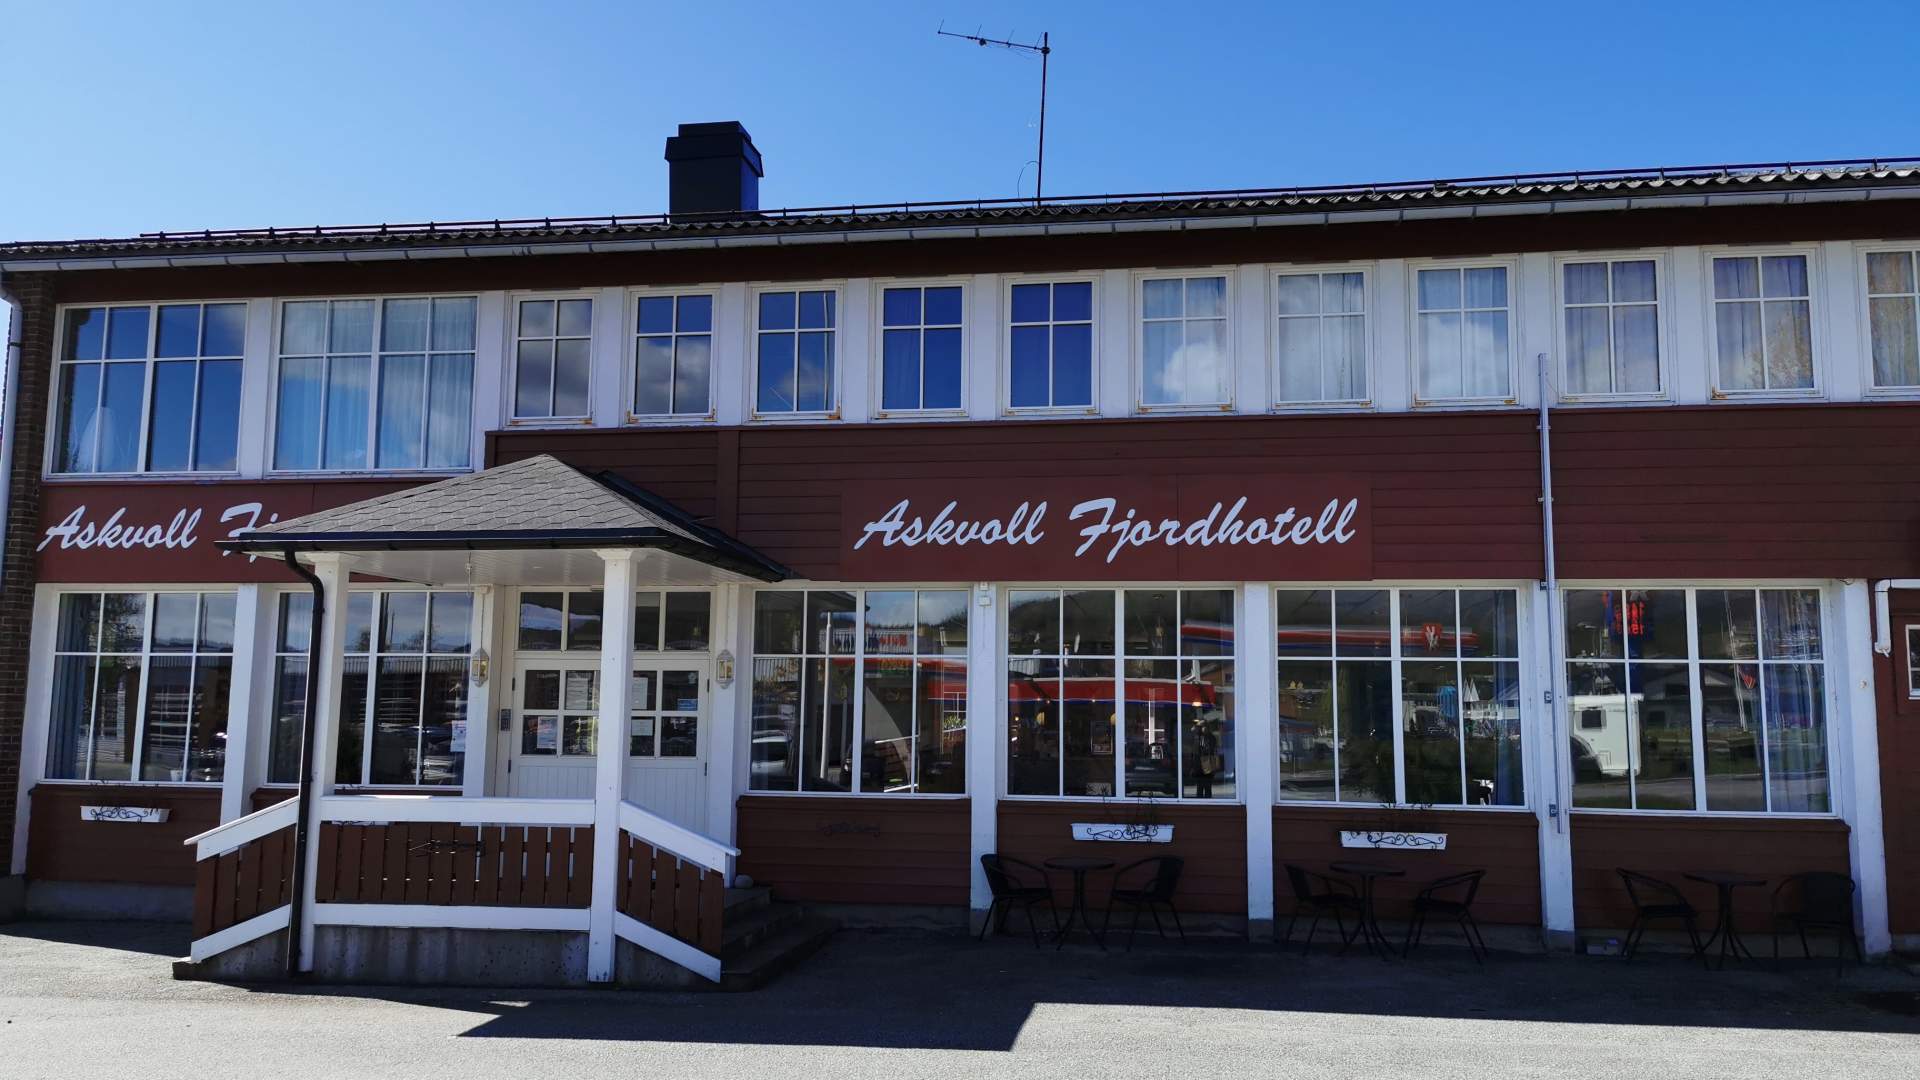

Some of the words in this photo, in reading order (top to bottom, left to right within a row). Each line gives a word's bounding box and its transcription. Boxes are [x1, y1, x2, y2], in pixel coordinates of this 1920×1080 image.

[37, 504, 202, 552] Askvoll
[854, 498, 1048, 550] Askvoll
[1069, 497, 1358, 564] Fjordhotell
